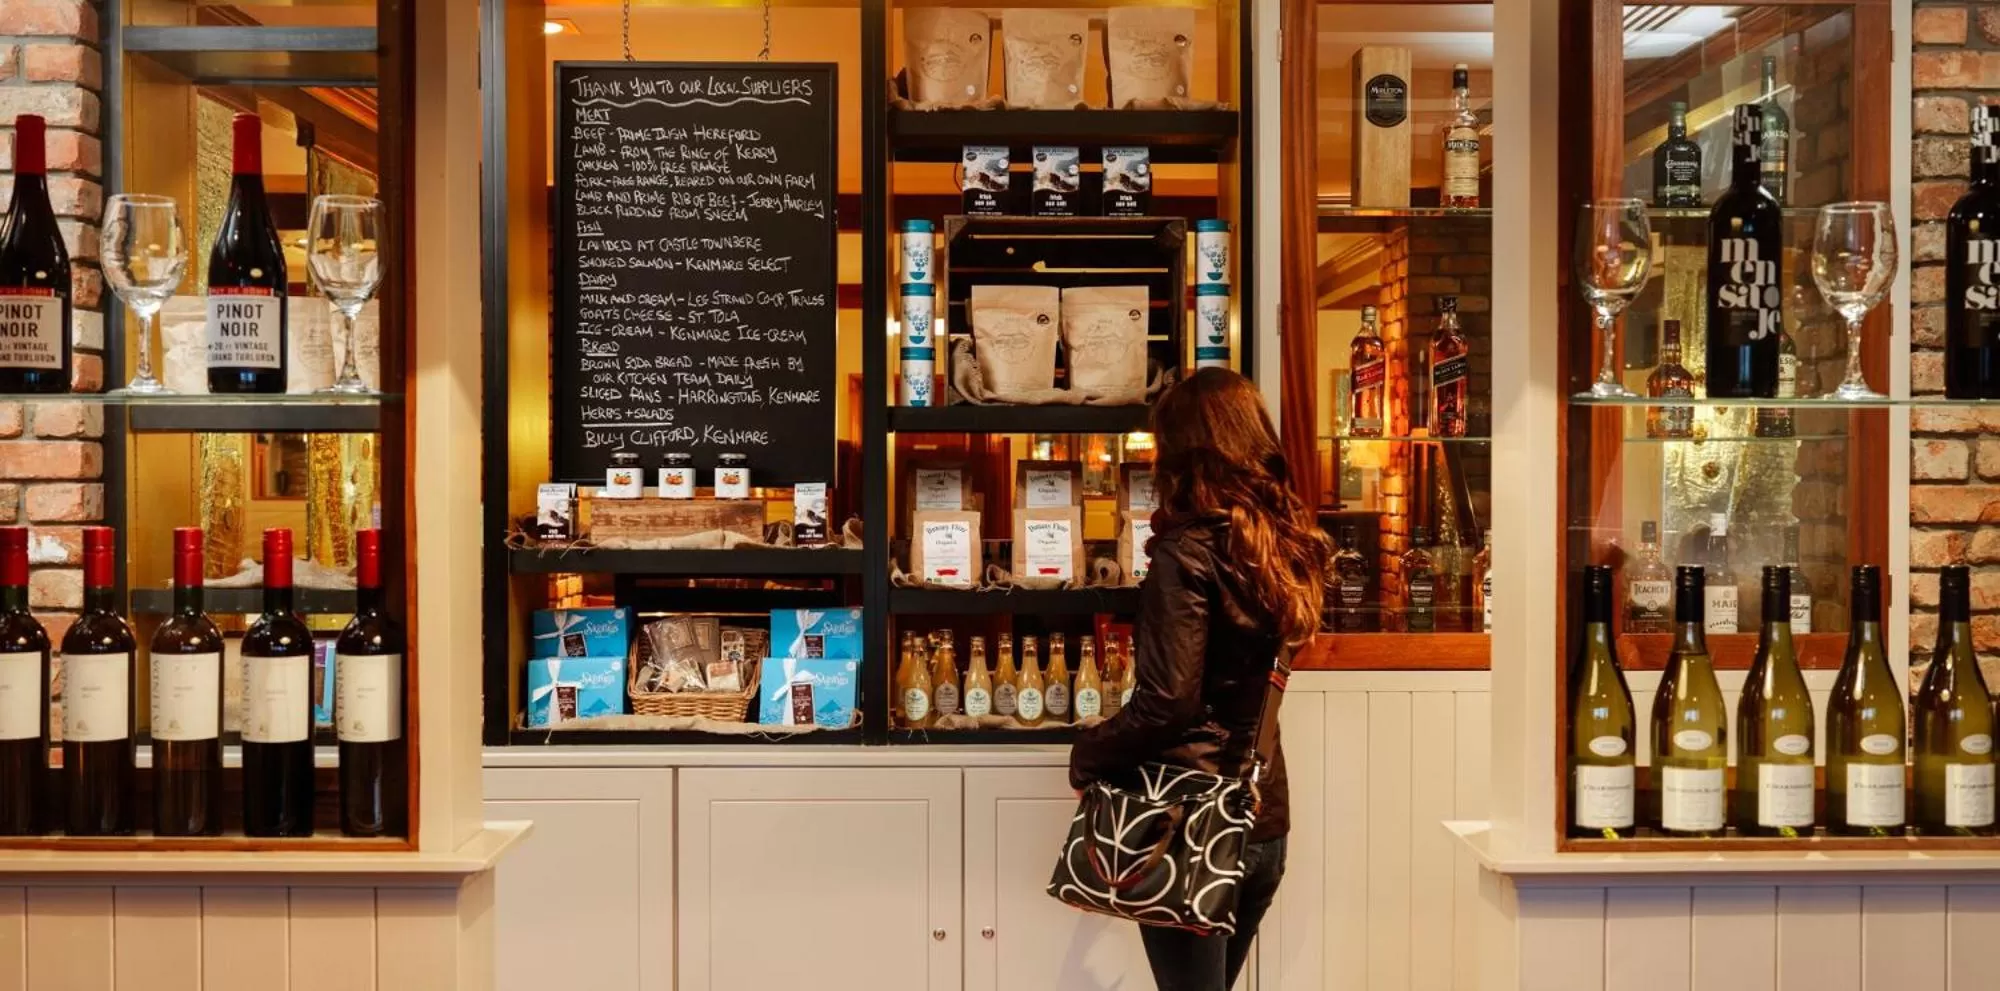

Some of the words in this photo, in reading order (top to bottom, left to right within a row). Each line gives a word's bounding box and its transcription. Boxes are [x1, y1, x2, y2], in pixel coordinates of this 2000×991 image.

[570, 76, 624, 97] THANK
[629, 77, 656, 96] YOU
[656, 79, 674, 95] TO
[680, 79, 704, 94] OUR
[741, 76, 813, 96] SUPPLIERS
[576, 107, 611, 122] MEAT
[570, 126, 606, 141] BEEF
[693, 123, 761, 144] HEREFORD
[574, 143, 606, 158] LAMB
[620, 145, 650, 160] FROM
[653, 146, 675, 158] THE
[680, 145, 711, 160] RING
[714, 146, 729, 163] OF
[735, 143, 778, 163] KERRY
[576, 159, 619, 171] CHICKEN
[658, 160, 686, 175] FREE
[691, 160, 730, 174] RANGE
[736, 173, 757, 186] OUR
[757, 173, 782, 186] OWN
[785, 173, 815, 190] FARM
[575, 189, 602, 201] LAMB
[606, 191, 631, 203] AND
[671, 191, 691, 205] RIB
[692, 195, 705, 208] OF
[747, 191, 783, 214] JERRY
[576, 203, 613, 216] BLACK
[616, 204, 664, 219] PUDDING
[669, 206, 700, 220] FROM
[704, 208, 748, 221] SNEEM
[637, 240, 655, 252] AT
[578, 256, 626, 268] SMOKED
[628, 257, 674, 270] SALMON
[686, 257, 744, 271] KENMARE
[747, 256, 792, 273] SELECT
[578, 272, 617, 287] DAIRY
[580, 294, 609, 305] MILK
[610, 293, 636, 304] AND
[638, 293, 676, 307] CREAM
[712, 290, 754, 305] STRAND
[217, 304, 264, 319] PINOT
[623, 308, 673, 321] CHEESE
[708, 308, 740, 323] TOLA
[0, 322, 38, 337] NOIR
[220, 322, 259, 337] NOIR
[576, 322, 654, 338] ICE-CREAM
[670, 326, 731, 342] KENMARE
[578, 338, 620, 352] BREAD
[580, 358, 621, 371] BROWN
[624, 356, 652, 369] SODA
[655, 355, 693, 369] BREAD
[707, 356, 739, 369] MADE
[743, 356, 780, 374] FRESH
[787, 356, 805, 372] BY
[593, 372, 615, 384] OUR
[617, 371, 668, 385] KITCHEN
[673, 372, 711, 386] TEAM
[715, 372, 754, 389] DAILY
[580, 386, 623, 401] SLICED
[629, 386, 662, 404] PANS
[769, 386, 821, 405] KENMARE
[580, 405, 622, 420] HERBS
[581, 430, 625, 451] BILLY
[704, 424, 769, 445] KENMARE
